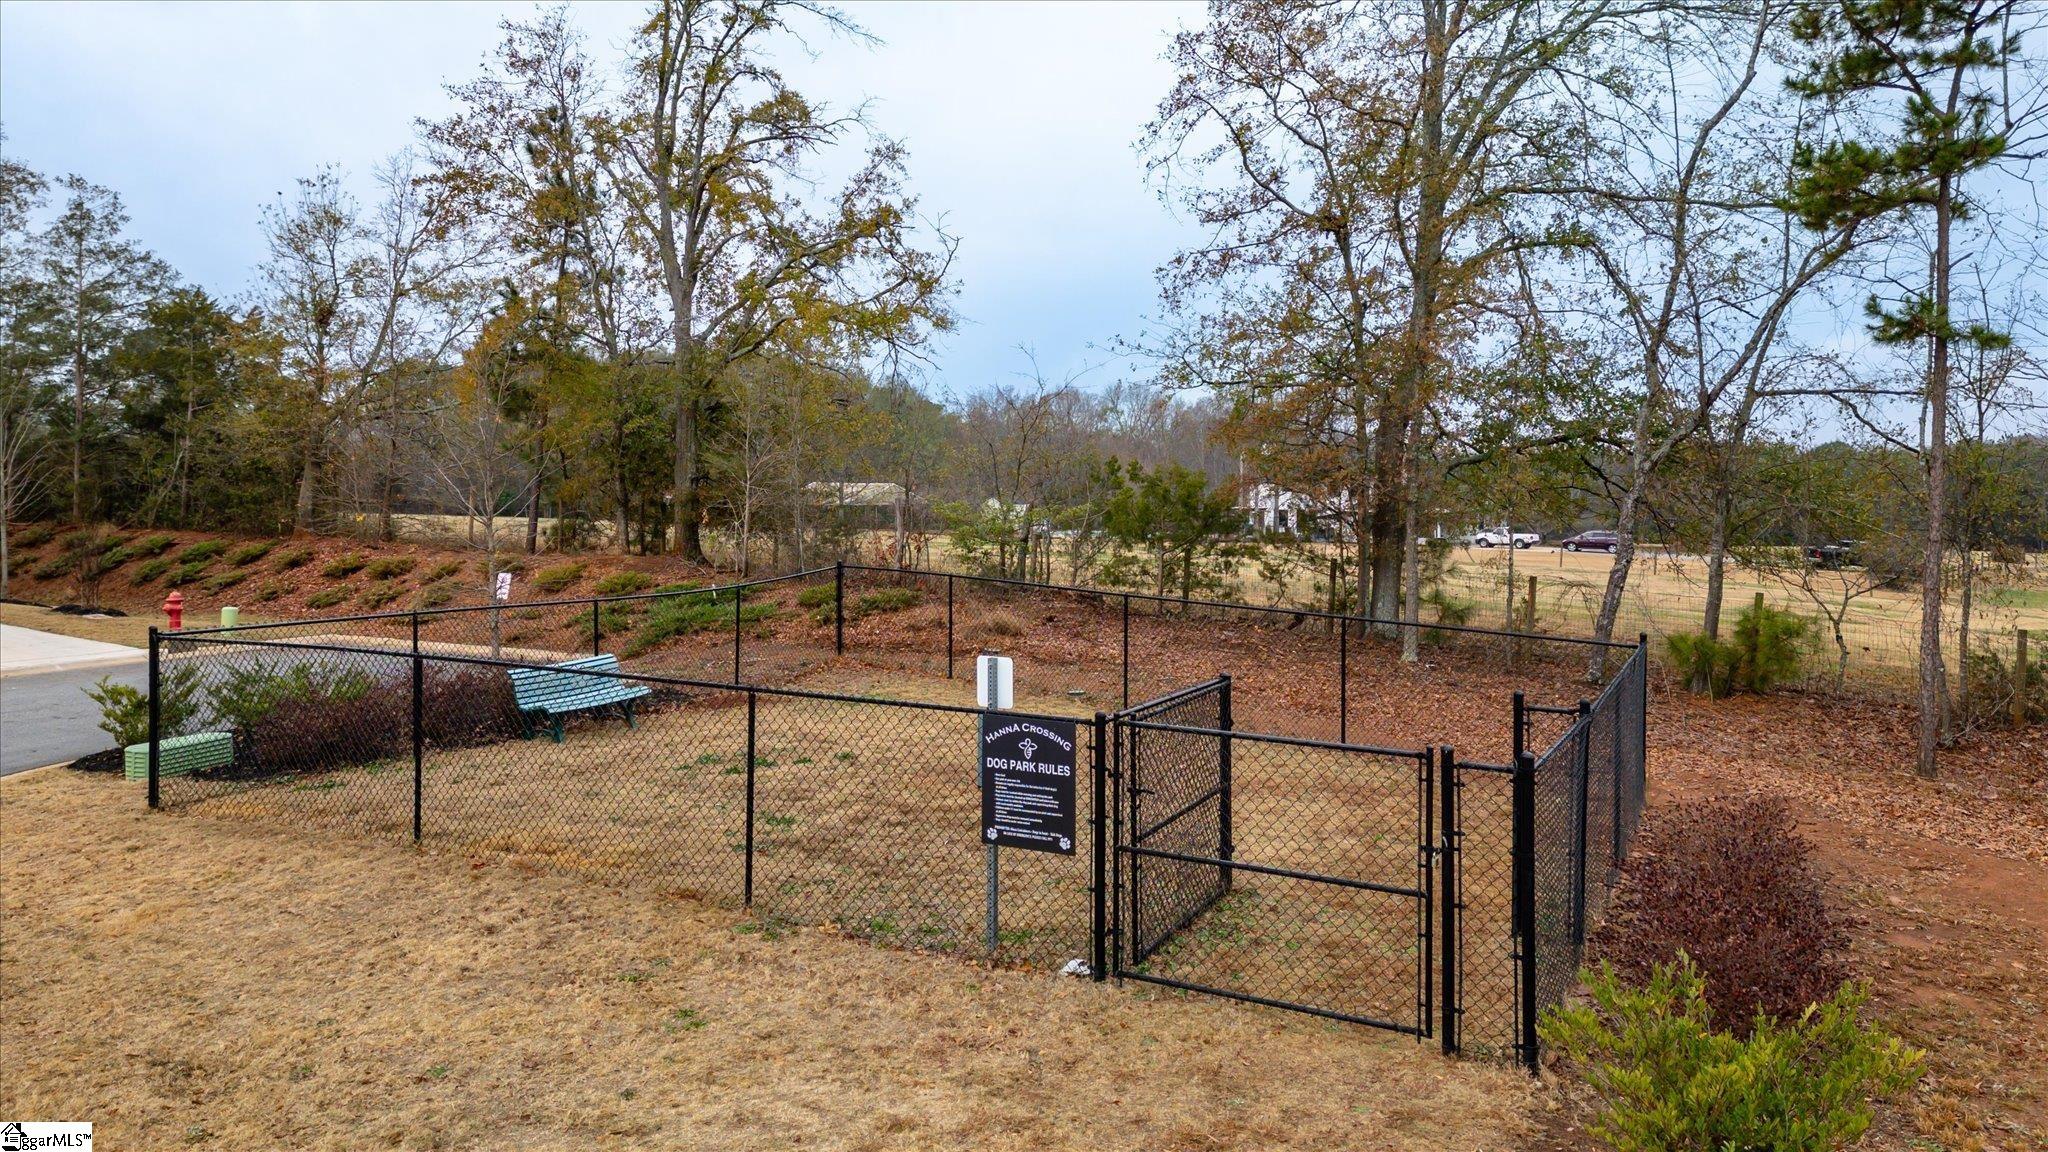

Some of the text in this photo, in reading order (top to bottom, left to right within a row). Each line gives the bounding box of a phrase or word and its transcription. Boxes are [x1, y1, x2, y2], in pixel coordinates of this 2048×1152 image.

[985, 723, 1072, 751] HANNA CROSSING
[986, 757, 1071, 776] DOG PARK RULES
